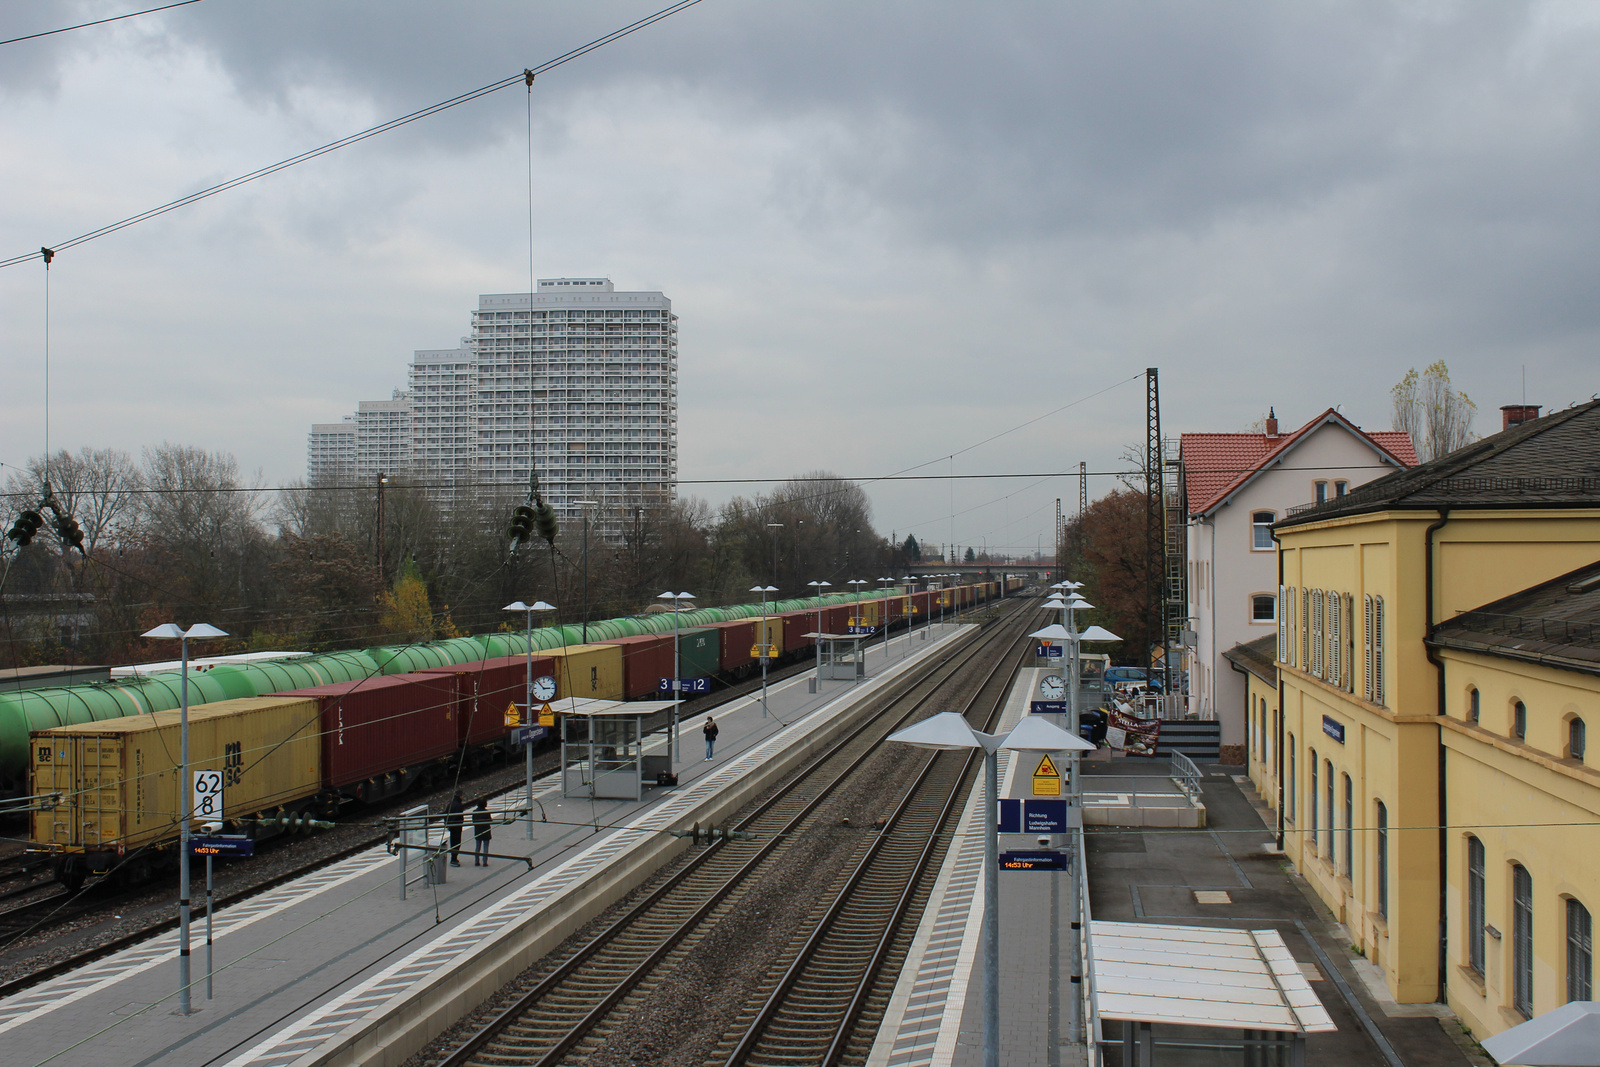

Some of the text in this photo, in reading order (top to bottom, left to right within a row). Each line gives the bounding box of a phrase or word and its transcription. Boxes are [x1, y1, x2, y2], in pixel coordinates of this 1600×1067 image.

[1037, 646, 1042, 655] 1
[660, 678, 668, 690] 3
[697, 678, 705, 690] 2
[1118, 718, 1139, 728] STELLA
[195, 773, 220, 794] 62
[202, 796, 213, 815] 8
